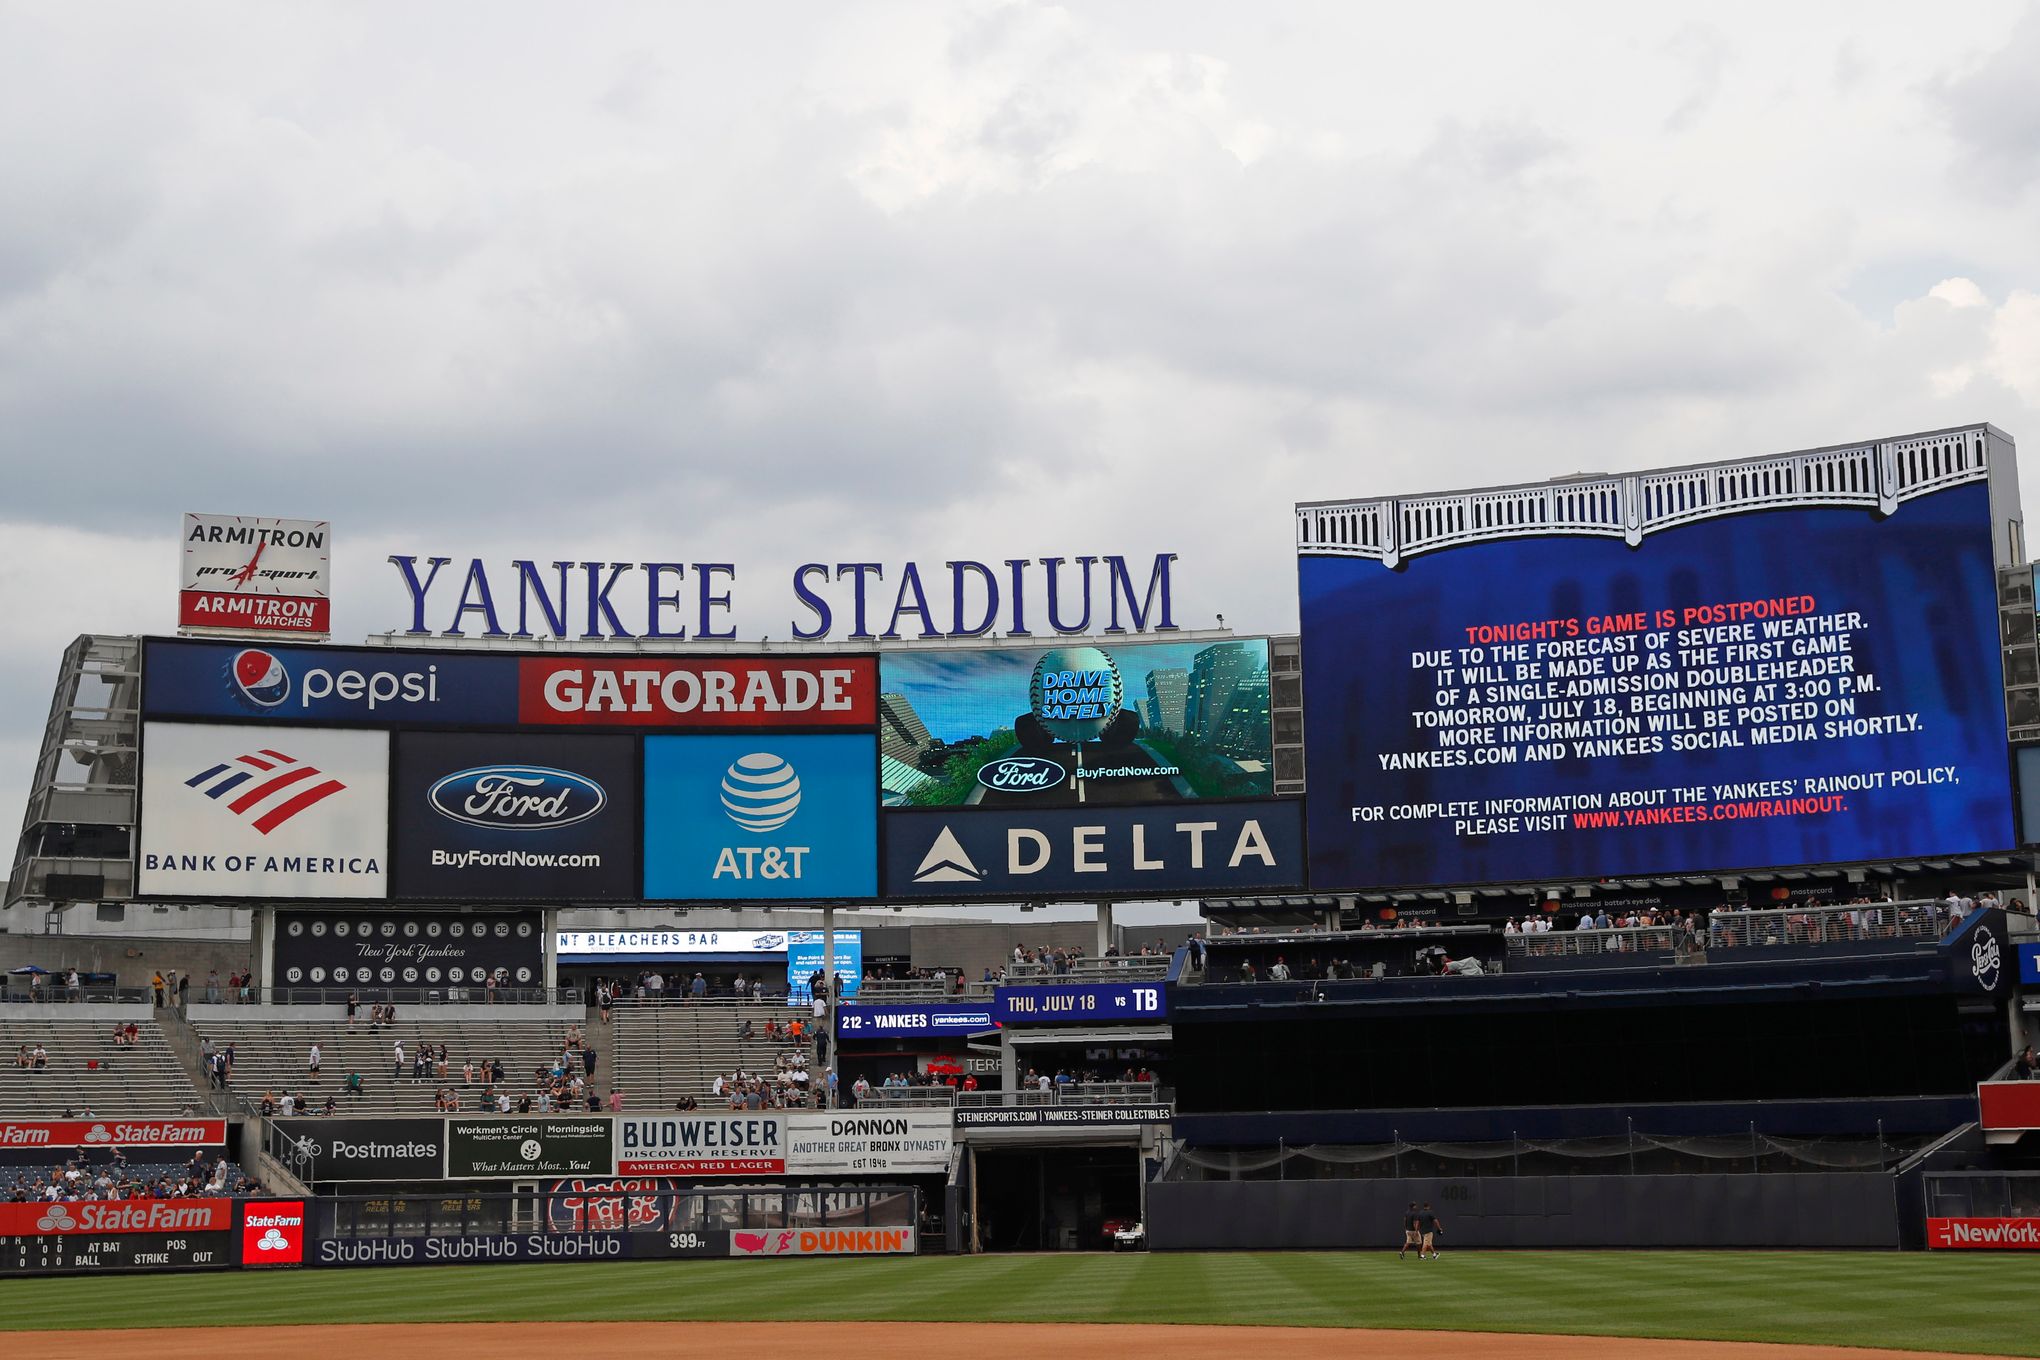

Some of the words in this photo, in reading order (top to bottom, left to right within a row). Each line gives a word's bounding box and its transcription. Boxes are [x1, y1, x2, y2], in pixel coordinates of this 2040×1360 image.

[189, 525, 323, 549] ARMITRON
[194, 596, 316, 617] ARMITRON
[387, 554, 737, 641] YANKEE
[792, 553, 1180, 641] STADIUM
[254, 615, 313, 627] WATCHES
[1466, 618, 1580, 645] TONIGHT'S
[1586, 612, 1648, 635] GAME
[1655, 609, 1676, 629] IS
[1683, 595, 1816, 627] POSTPONED
[1411, 650, 1453, 669] DUE
[1458, 647, 1485, 665] TO
[1490, 644, 1530, 663] THE
[1536, 634, 1638, 660] FORECAST
[1645, 631, 1671, 650] OF
[1678, 623, 1756, 648] SEVERE
[1762, 611, 1869, 639] WEATHER.
[1437, 669, 1455, 687] IT
[1462, 665, 1509, 685] WILL
[1515, 662, 1542, 681] BE
[1548, 657, 1606, 678] MADE
[1612, 655, 1640, 673] UP
[1646, 652, 1672, 670] AS
[1678, 648, 1720, 668] THE
[1726, 640, 1785, 664] FIRST
[1791, 633, 1852, 657] GAME
[302, 664, 437, 710] pepsi
[1042, 670, 1112, 689] DRIVE
[1435, 689, 1461, 707] OF
[1467, 688, 1481, 705] A
[1486, 672, 1679, 703] SINGLE-ADMISSION
[1687, 655, 1855, 687] DOUBLEHEADER
[544, 669, 853, 712] GATORADE
[1044, 687, 1112, 705] HOME
[1412, 705, 1532, 729] TOMORROW,
[1538, 700, 1585, 721] JULY
[1593, 698, 1624, 719] 18,
[1630, 687, 1747, 713] BEGINNING
[1753, 684, 1778, 703] AT
[1784, 678, 1832, 700] 3:00
[1838, 674, 1882, 695] P.M.
[1042, 703, 1115, 720] SAFELY
[1439, 728, 1495, 747] MORE
[1503, 715, 1641, 743] INFORMATION
[1649, 713, 1697, 733] WILL
[1703, 710, 1731, 729] BE
[1737, 701, 1819, 726] POSTED
[1824, 698, 1856, 717] ON
[1378, 747, 1518, 771] YANKEES.COM
[1524, 743, 1567, 763] AND
[1572, 736, 1664, 759] YANKEES
[1671, 730, 1745, 751] SOCIAL
[1750, 723, 1818, 745] MEDIA
[1824, 713, 1923, 739] SHORTLY.
[992, 762, 1050, 786] Ford
[1076, 766, 1180, 780] BuyFordNow.com
[464, 774, 571, 818] Ford
[1352, 806, 1385, 822] FOR
[1389, 801, 1479, 821] COMPLETE
[1485, 793, 1602, 815] INFORMATION
[1608, 789, 1668, 808] ABOUT
[1672, 786, 1708, 803] THE
[1712, 779, 1799, 801] YANKEES'
[1805, 772, 1886, 794] RAINOUT
[1891, 766, 1961, 786] POLICY,
[1455, 818, 1520, 836] PLEASE
[1525, 814, 1567, 832] VISIT
[1573, 795, 1849, 829] WWW.YANKEES.COM/RAINOUT.
[1007, 819, 1278, 876] DELTA
[145, 854, 218, 872] BANK
[225, 856, 257, 872] OF
[264, 857, 380, 874] AMERICA
[432, 849, 600, 868] BuyFordNow.com
[713, 846, 810, 880] AT&T
[1791, 887, 1833, 896] mastercard
[1397, 908, 1436, 917] mastercard
[383, 924, 394, 934] 37
[452, 924, 462, 934] 16
[474, 924, 484, 934] 15
[496, 924, 508, 934] 32
[587, 934, 680, 946] BLEACHERS
[688, 933, 718, 945] BAR
[355, 943, 384, 957] New
[384, 943, 416, 963] York
[416, 943, 466, 963] Yankees
[289, 969, 300, 980] 10
[335, 969, 347, 980] 44
[359, 969, 370, 980] 23
[382, 969, 393, 980] 49
[405, 969, 416, 980] 42
[451, 969, 461, 980] 51
[473, 969, 484, 980] 46
[496, 969, 508, 980] 2
[1008, 997, 1038, 1014] THU,
[1042, 996, 1074, 1013] JULY
[1079, 995, 1096, 1010] 18
[1133, 989, 1158, 1011] TB
[842, 1016, 862, 1029] 212
[874, 1014, 927, 1028] YANKEES
[934, 1015, 988, 1026] yankees.com
[957, 1111, 1037, 1123] STEINERSPORTS.COM
[1044, 1110, 1113, 1121] YANKEES-STEINER
[1115, 1109, 1170, 1120] COLLECTIBLES
[457, 1125, 508, 1134] Workmen's
[511, 1125, 538, 1134] Circle
[547, 1124, 605, 1135] Morningside
[623, 1120, 779, 1147] BUDWEISER
[831, 1119, 908, 1136] DANNON
[332, 1141, 437, 1159] Postmates
[624, 1150, 704, 1158] DISCOVERY
[711, 1149, 777, 1157] RESERVE
[792, 1142, 837, 1153] ANOTHER
[838, 1141, 868, 1152] GREAT
[870, 1140, 901, 1152] BRONX
[903, 1140, 947, 1152] DYNASTY
[472, 1161, 497, 1171] What
[499, 1161, 535, 1171] Matters
[629, 1162, 696, 1171] AMERICAN
[700, 1162, 726, 1170] RED
[730, 1161, 773, 1170] LAGER
[853, 1160, 866, 1169] EST
[869, 1160, 887, 1168] 1942
[15, 1236, 21, 1245] R
[37, 1236, 43, 1244] H
[57, 1235, 63, 1243] E
[88, 1243, 100, 1253] AT
[103, 1241, 121, 1252] BAT
[166, 1239, 187, 1250] POS
[320, 1240, 414, 1262] StubHub
[425, 1236, 518, 1259] StubHub
[527, 1233, 621, 1256] StubHub
[670, 1234, 697, 1249] 399
[800, 1230, 909, 1252] DUNKIN'
[20, 1258, 25, 1267] 0
[41, 1257, 47, 1266] 0
[56, 1257, 62, 1266] 0
[75, 1255, 100, 1266] BALL
[134, 1253, 169, 1264] STRIKE
[193, 1252, 213, 1263] OUT
